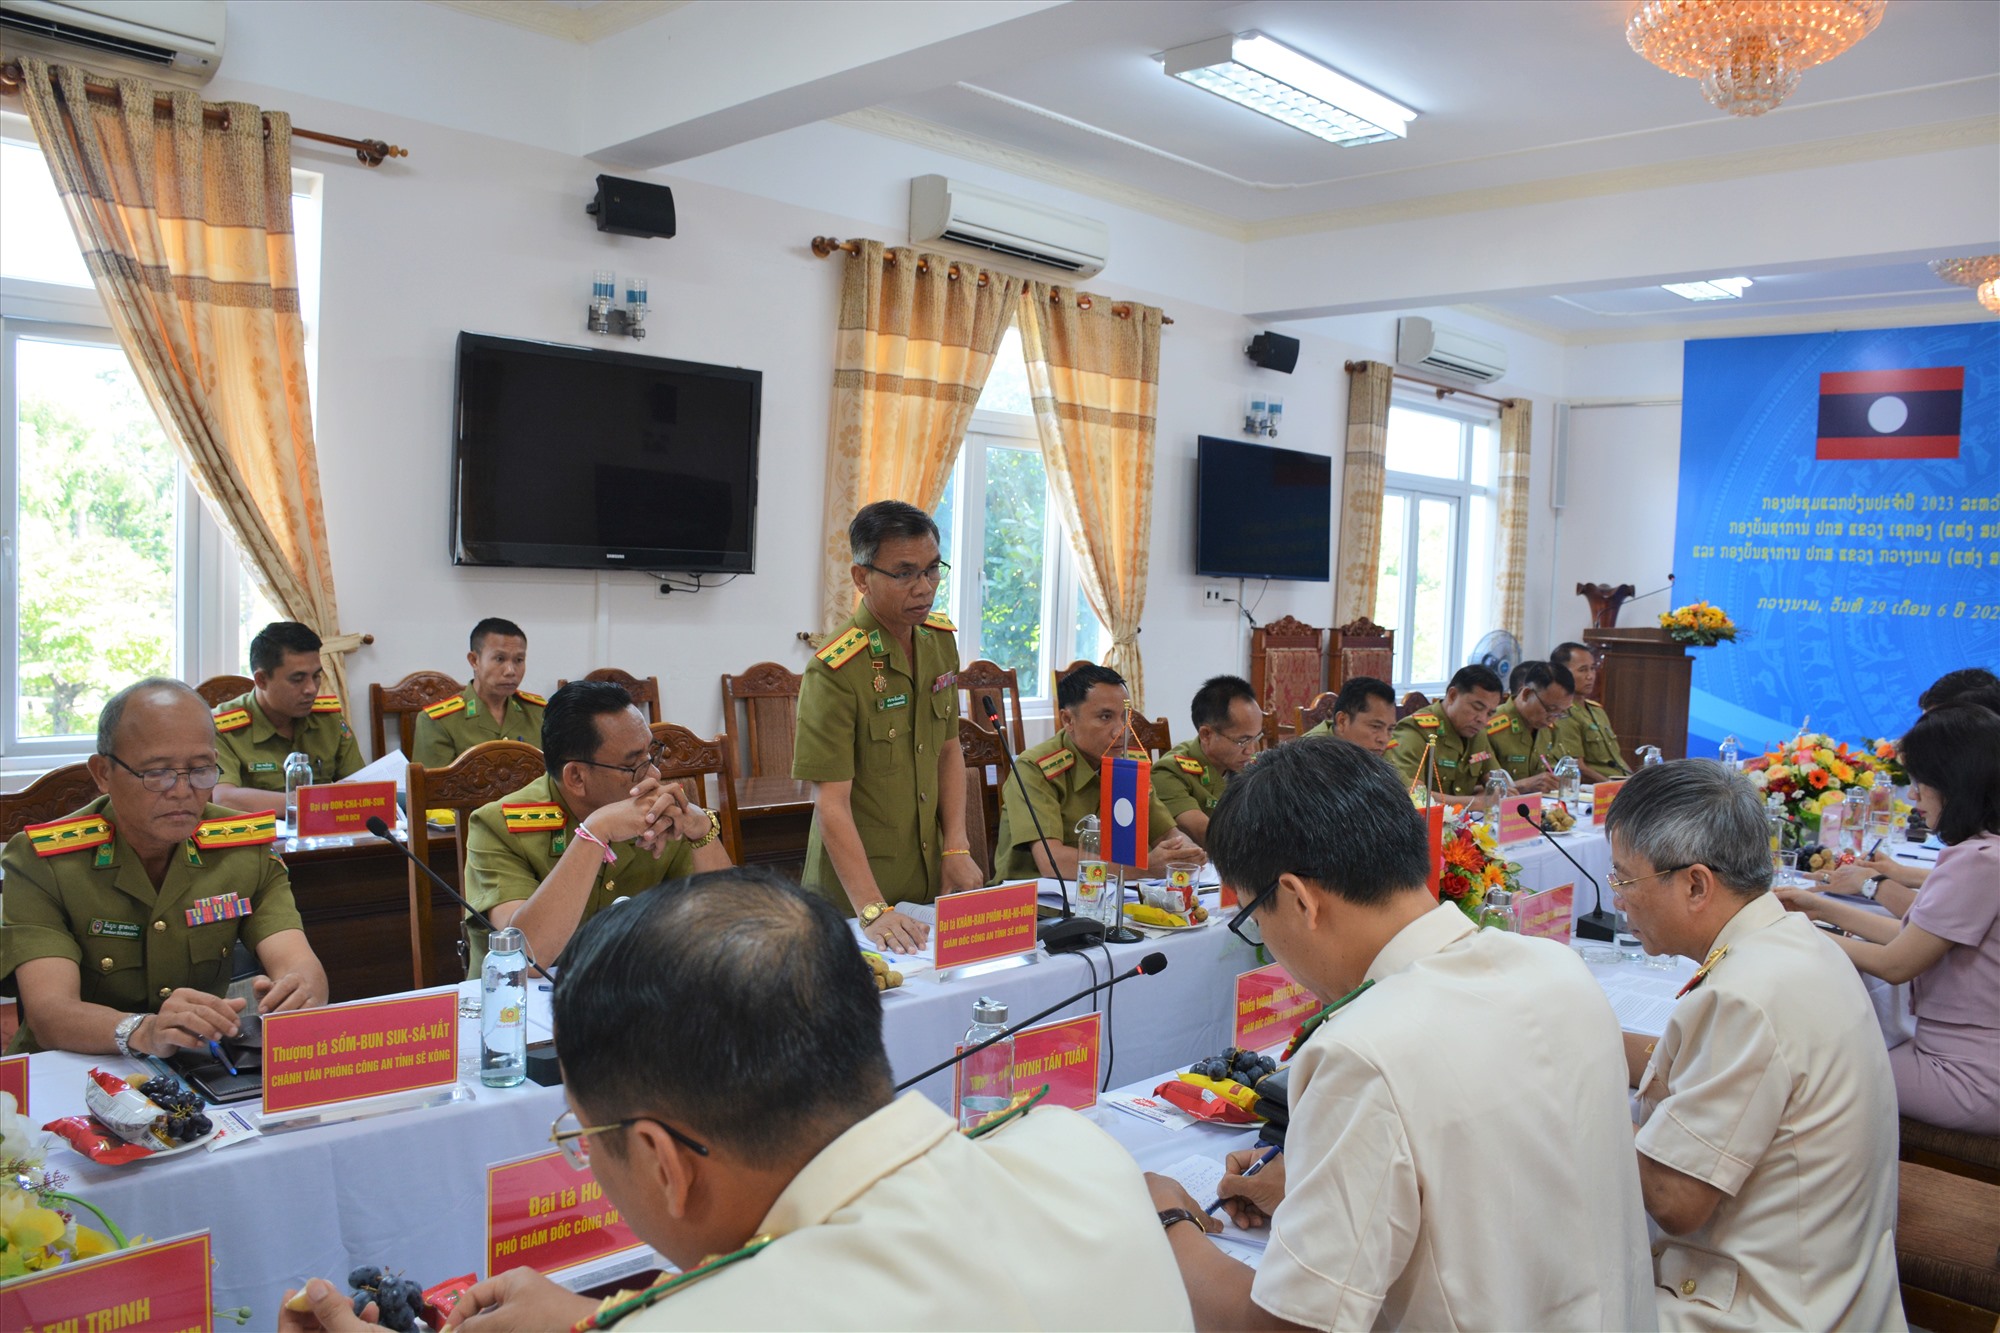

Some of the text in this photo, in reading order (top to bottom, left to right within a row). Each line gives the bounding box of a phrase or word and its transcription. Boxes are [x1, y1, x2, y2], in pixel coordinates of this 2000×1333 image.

[1921, 496, 1954, 511] 2023
[1867, 601, 1887, 615] 29
[1937, 603, 1948, 617] 6
[943, 937, 958, 949] GIÁM
[970, 932, 985, 943] CÔNG
[986, 931, 994, 941] AN
[272, 1043, 314, 1063] Thượng
[317, 1040, 328, 1056] tá
[331, 1031, 384, 1055] SỔM-BUN
[1044, 1049, 1062, 1072] TẤN
[1064, 1043, 1089, 1066] TUẤN
[271, 1048, 450, 1087] CHÁNH VĂN PHÒNG CÔNG AN TỈNH SÊ KÔNG
[529, 1191, 556, 1218] Đại
[560, 1186, 576, 1209] tá
[495, 1209, 619, 1258] PHÓ GIÁM ĐỐC CÔNG AN
[85, 1297, 150, 1333] TRINH
